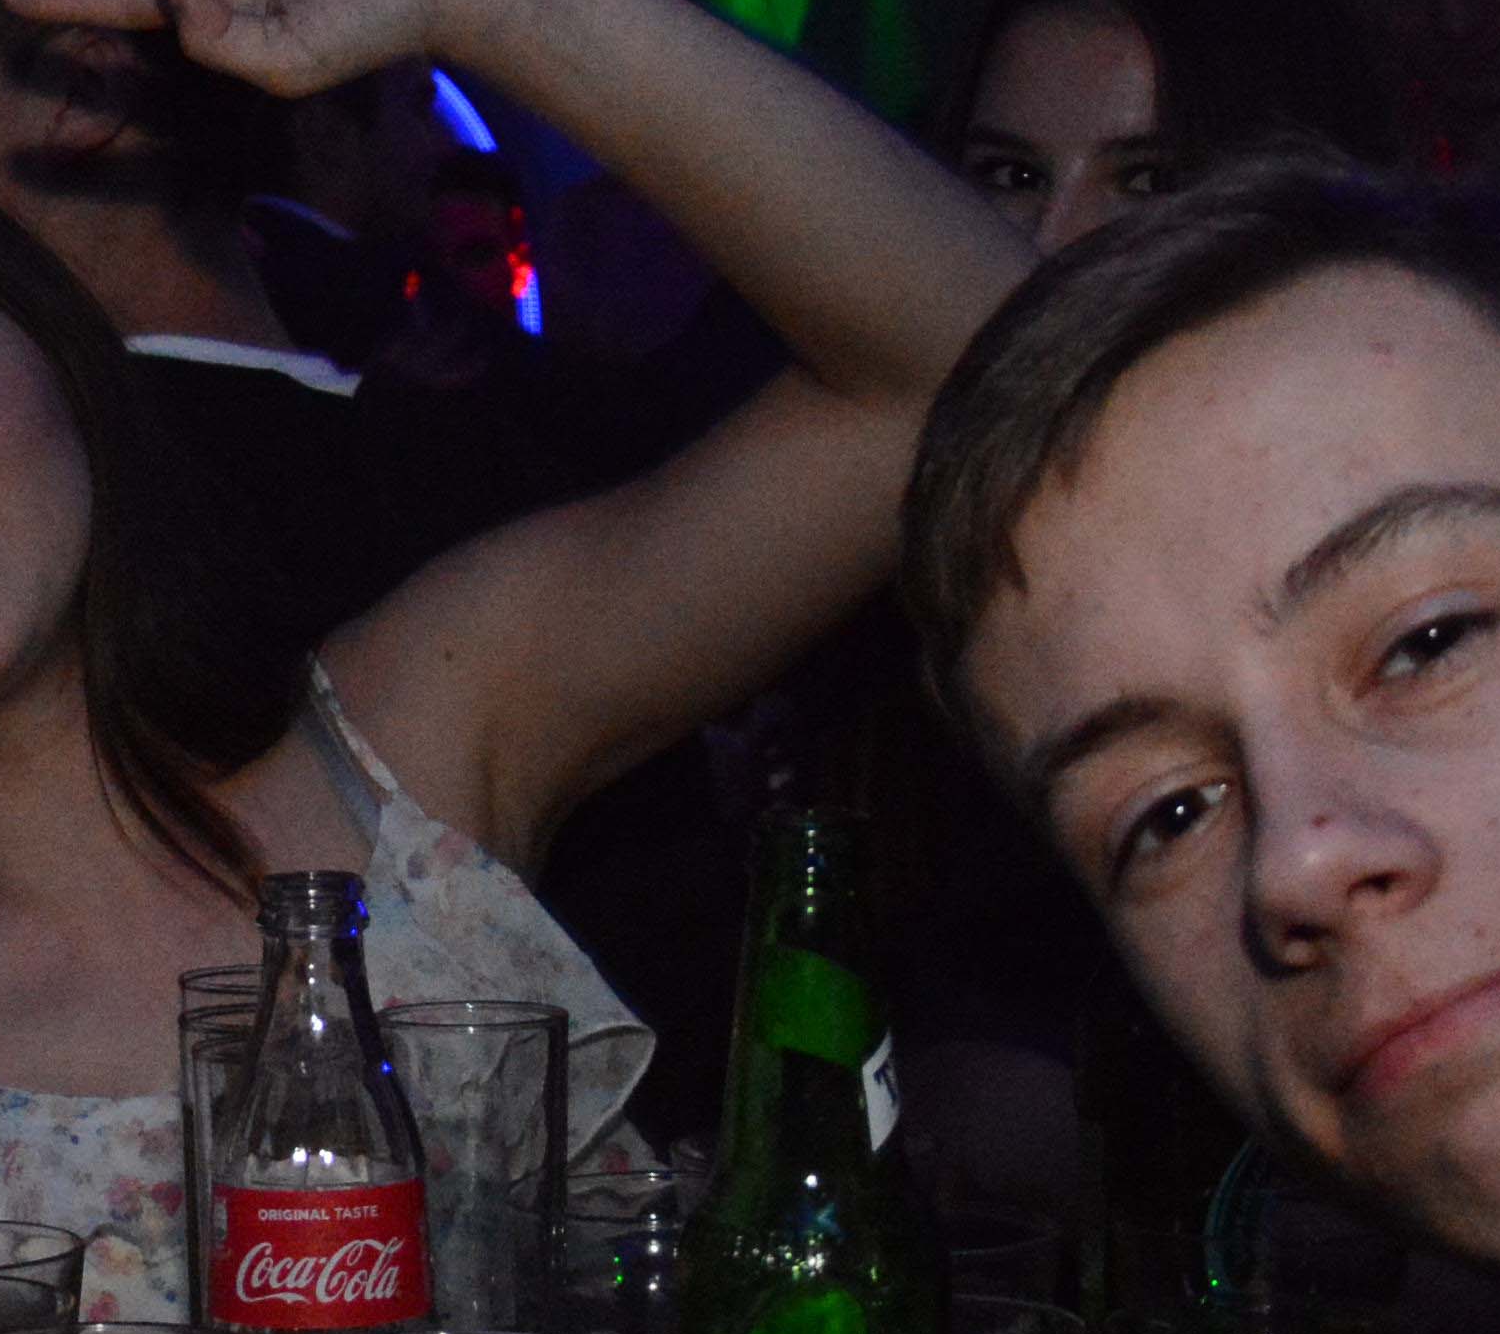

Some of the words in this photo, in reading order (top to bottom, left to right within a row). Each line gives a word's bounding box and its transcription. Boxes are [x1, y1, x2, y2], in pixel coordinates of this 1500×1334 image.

[258, 1208, 330, 1221] ORIGINAL
[334, 1205, 379, 1219] TASTE
[236, 1236, 405, 1304] Coca-Cola
